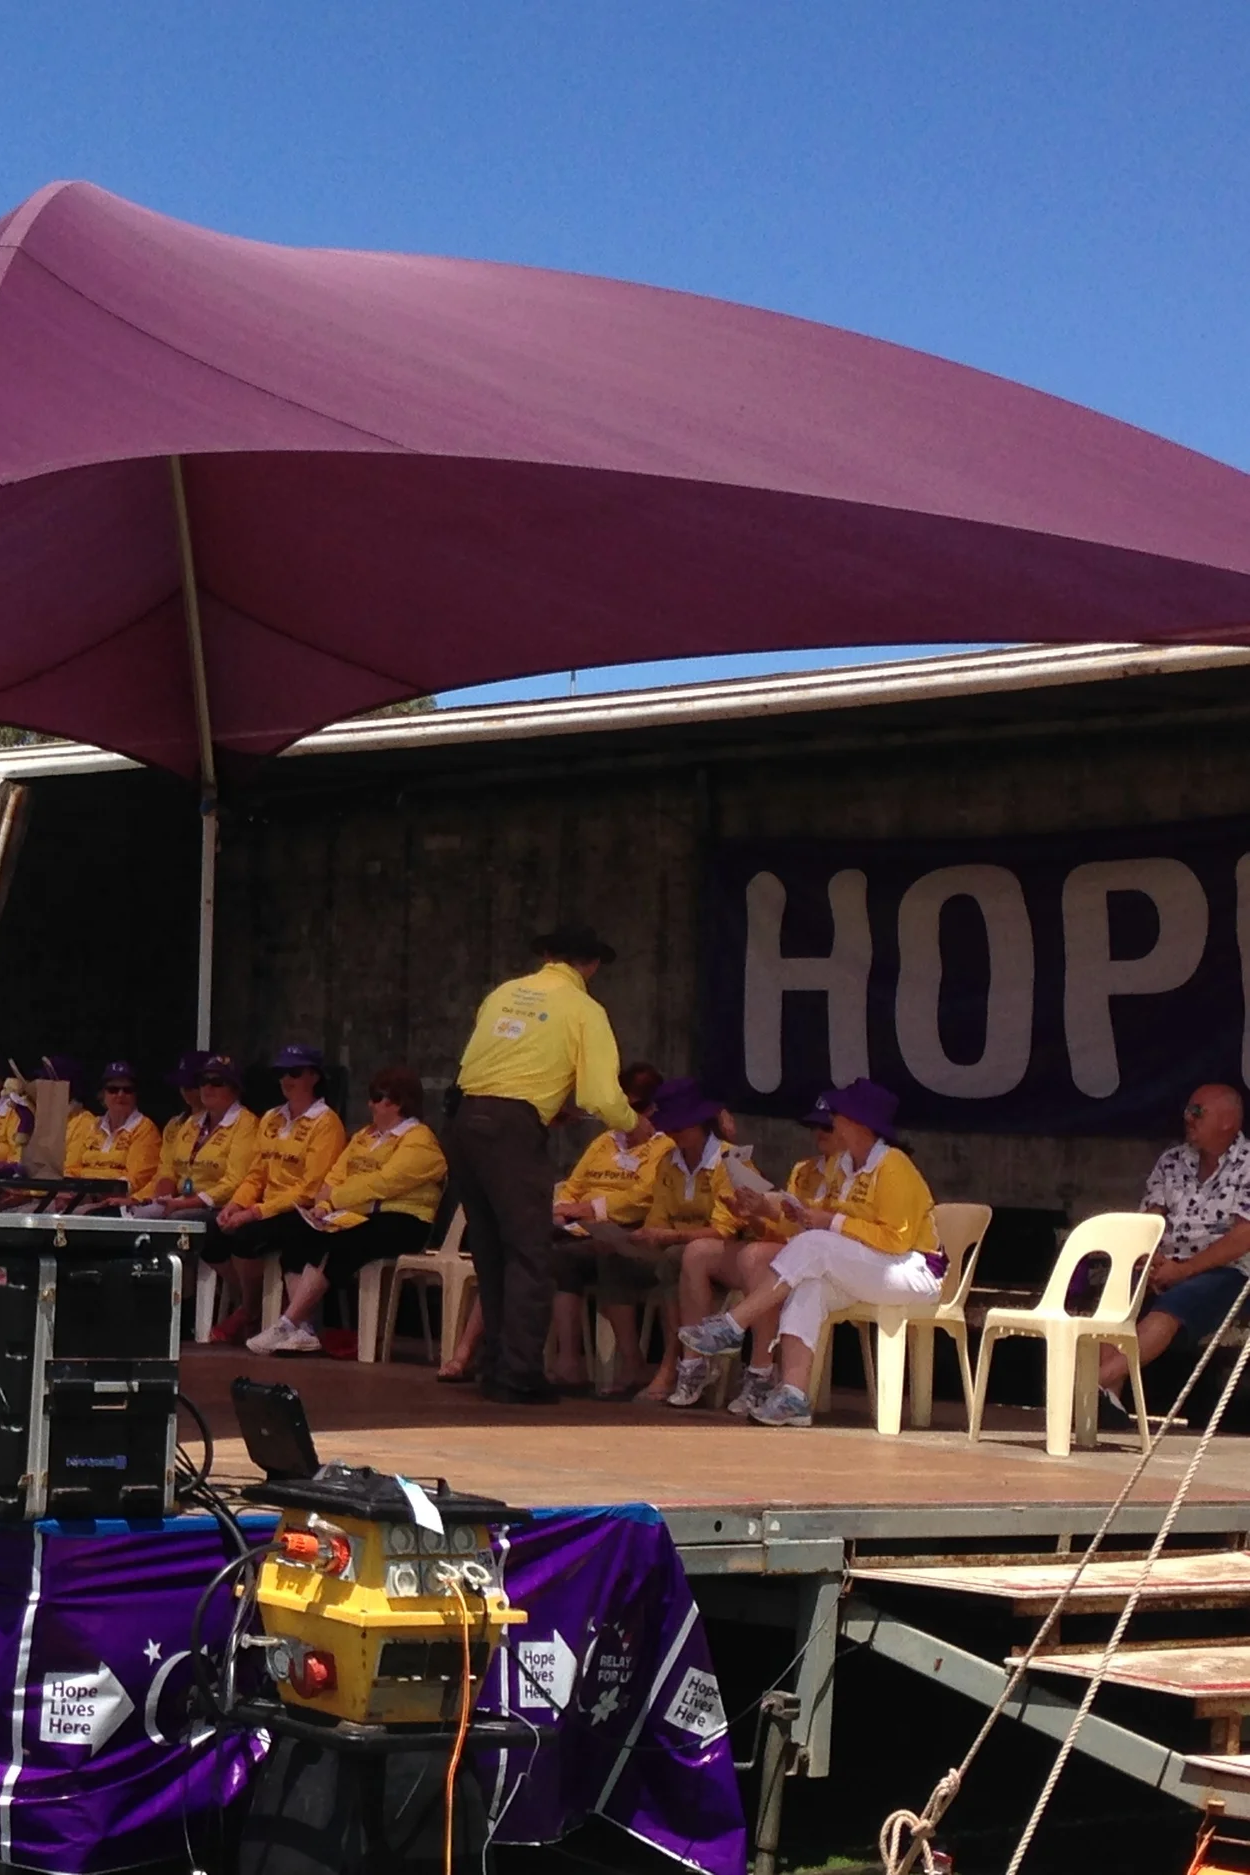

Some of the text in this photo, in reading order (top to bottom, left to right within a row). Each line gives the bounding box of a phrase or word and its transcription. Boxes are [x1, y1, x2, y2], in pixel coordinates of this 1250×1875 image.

[744, 852, 1250, 1099] HOP
[524, 1650, 556, 1668] Hope
[600, 1655, 632, 1669] RELAY
[597, 1669, 619, 1683] FOR
[52, 1681, 98, 1700] Hope
[50, 1699, 95, 1717] Lives
[681, 1690, 714, 1713] Lives
[674, 1705, 706, 1727] Here
[49, 1717, 92, 1735] Here
